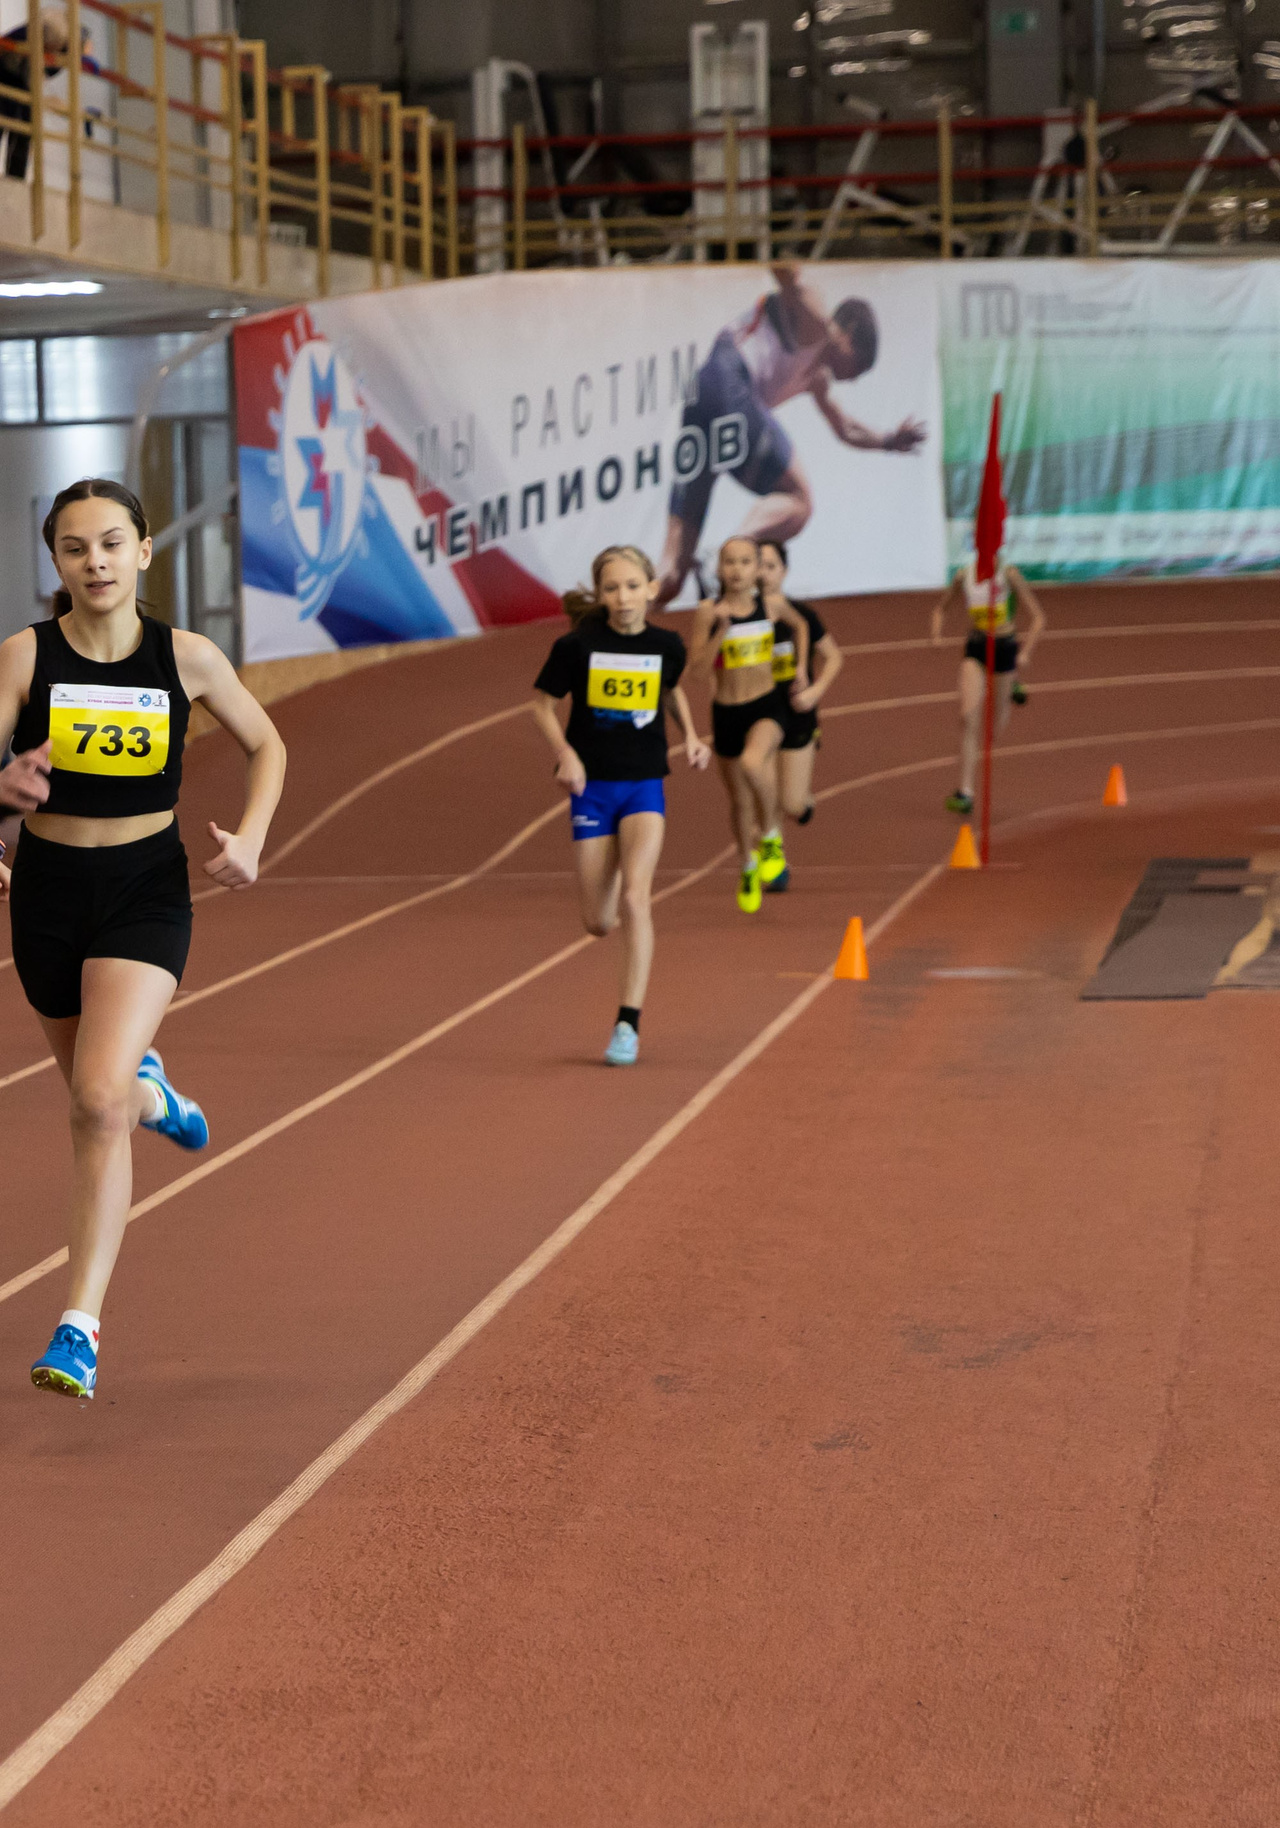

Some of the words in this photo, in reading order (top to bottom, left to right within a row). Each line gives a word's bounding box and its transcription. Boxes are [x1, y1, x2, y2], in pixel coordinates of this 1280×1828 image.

[415, 413, 476, 490] МЫ
[512, 343, 701, 457] РАСТИМ
[414, 416, 745, 566] ЧЕМПИОНОВ
[602, 678, 648, 698] 631
[73, 723, 151, 757] 733
